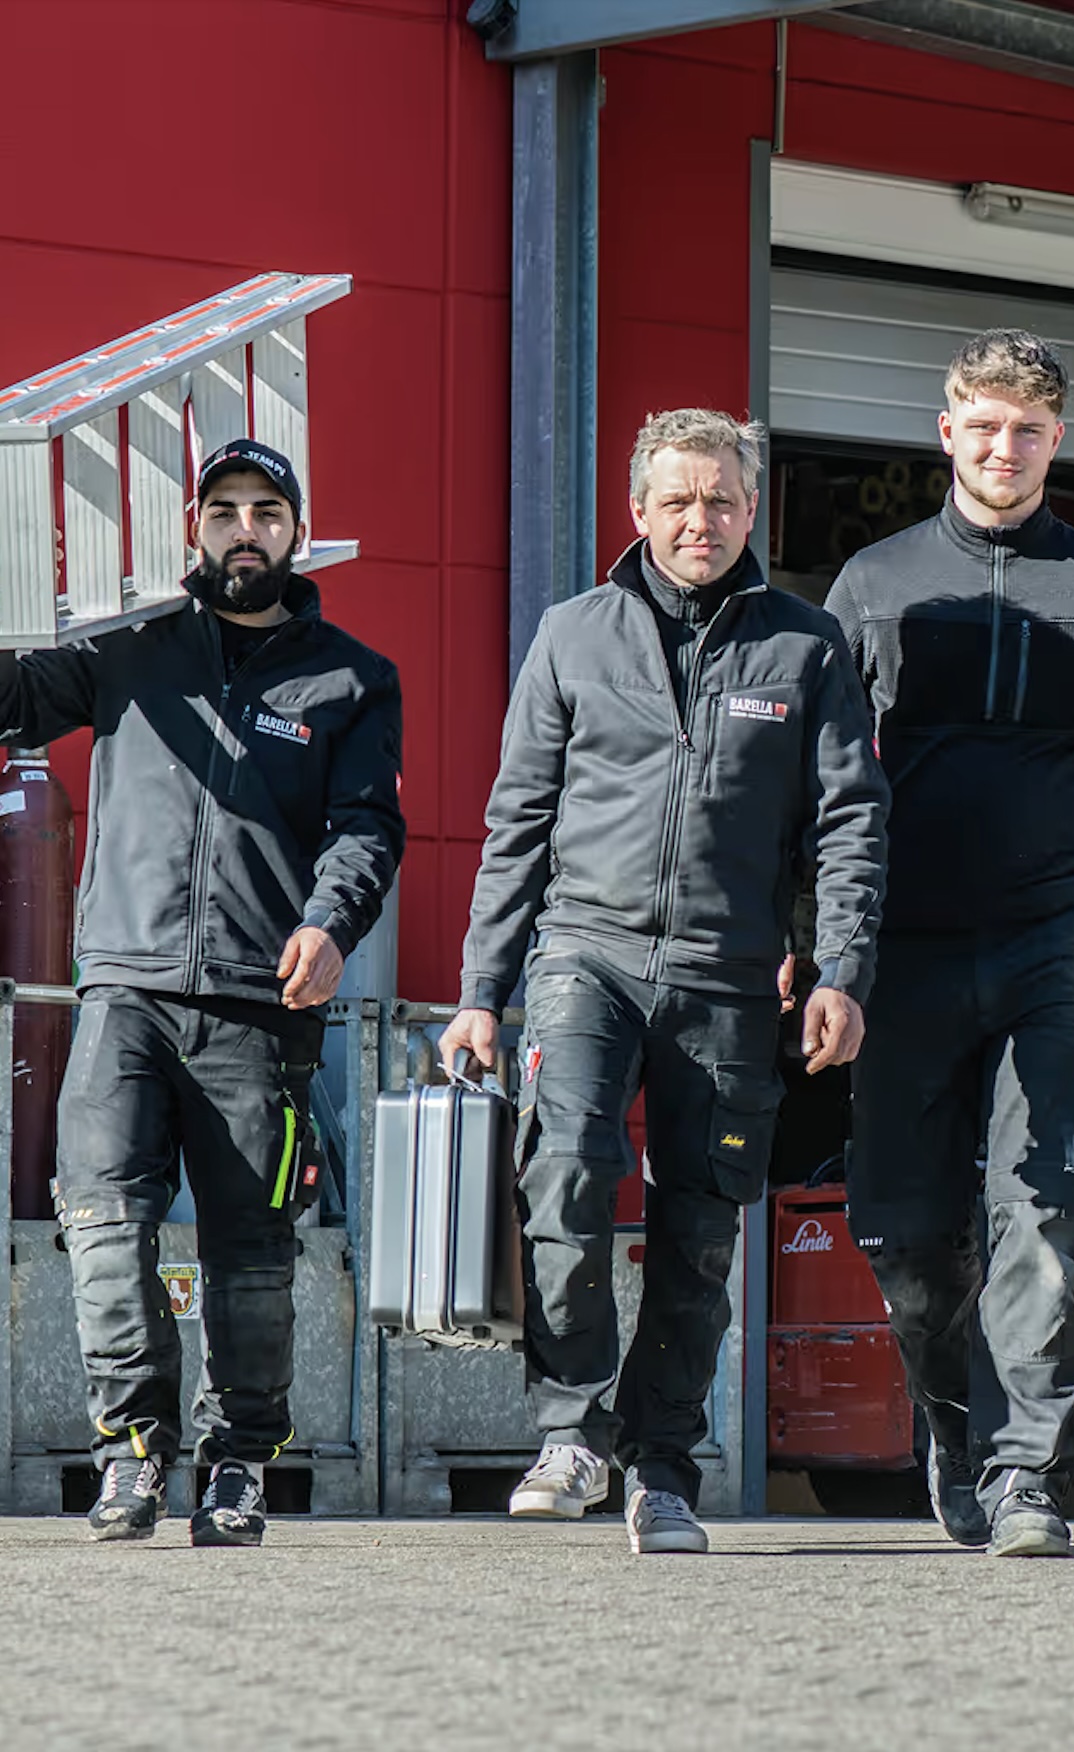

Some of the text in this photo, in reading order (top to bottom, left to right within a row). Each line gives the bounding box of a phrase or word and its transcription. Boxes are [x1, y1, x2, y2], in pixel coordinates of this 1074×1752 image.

[729, 696, 774, 715] BARELLA
[256, 713, 298, 736] BARELLA
[782, 1220, 834, 1254] Linde
